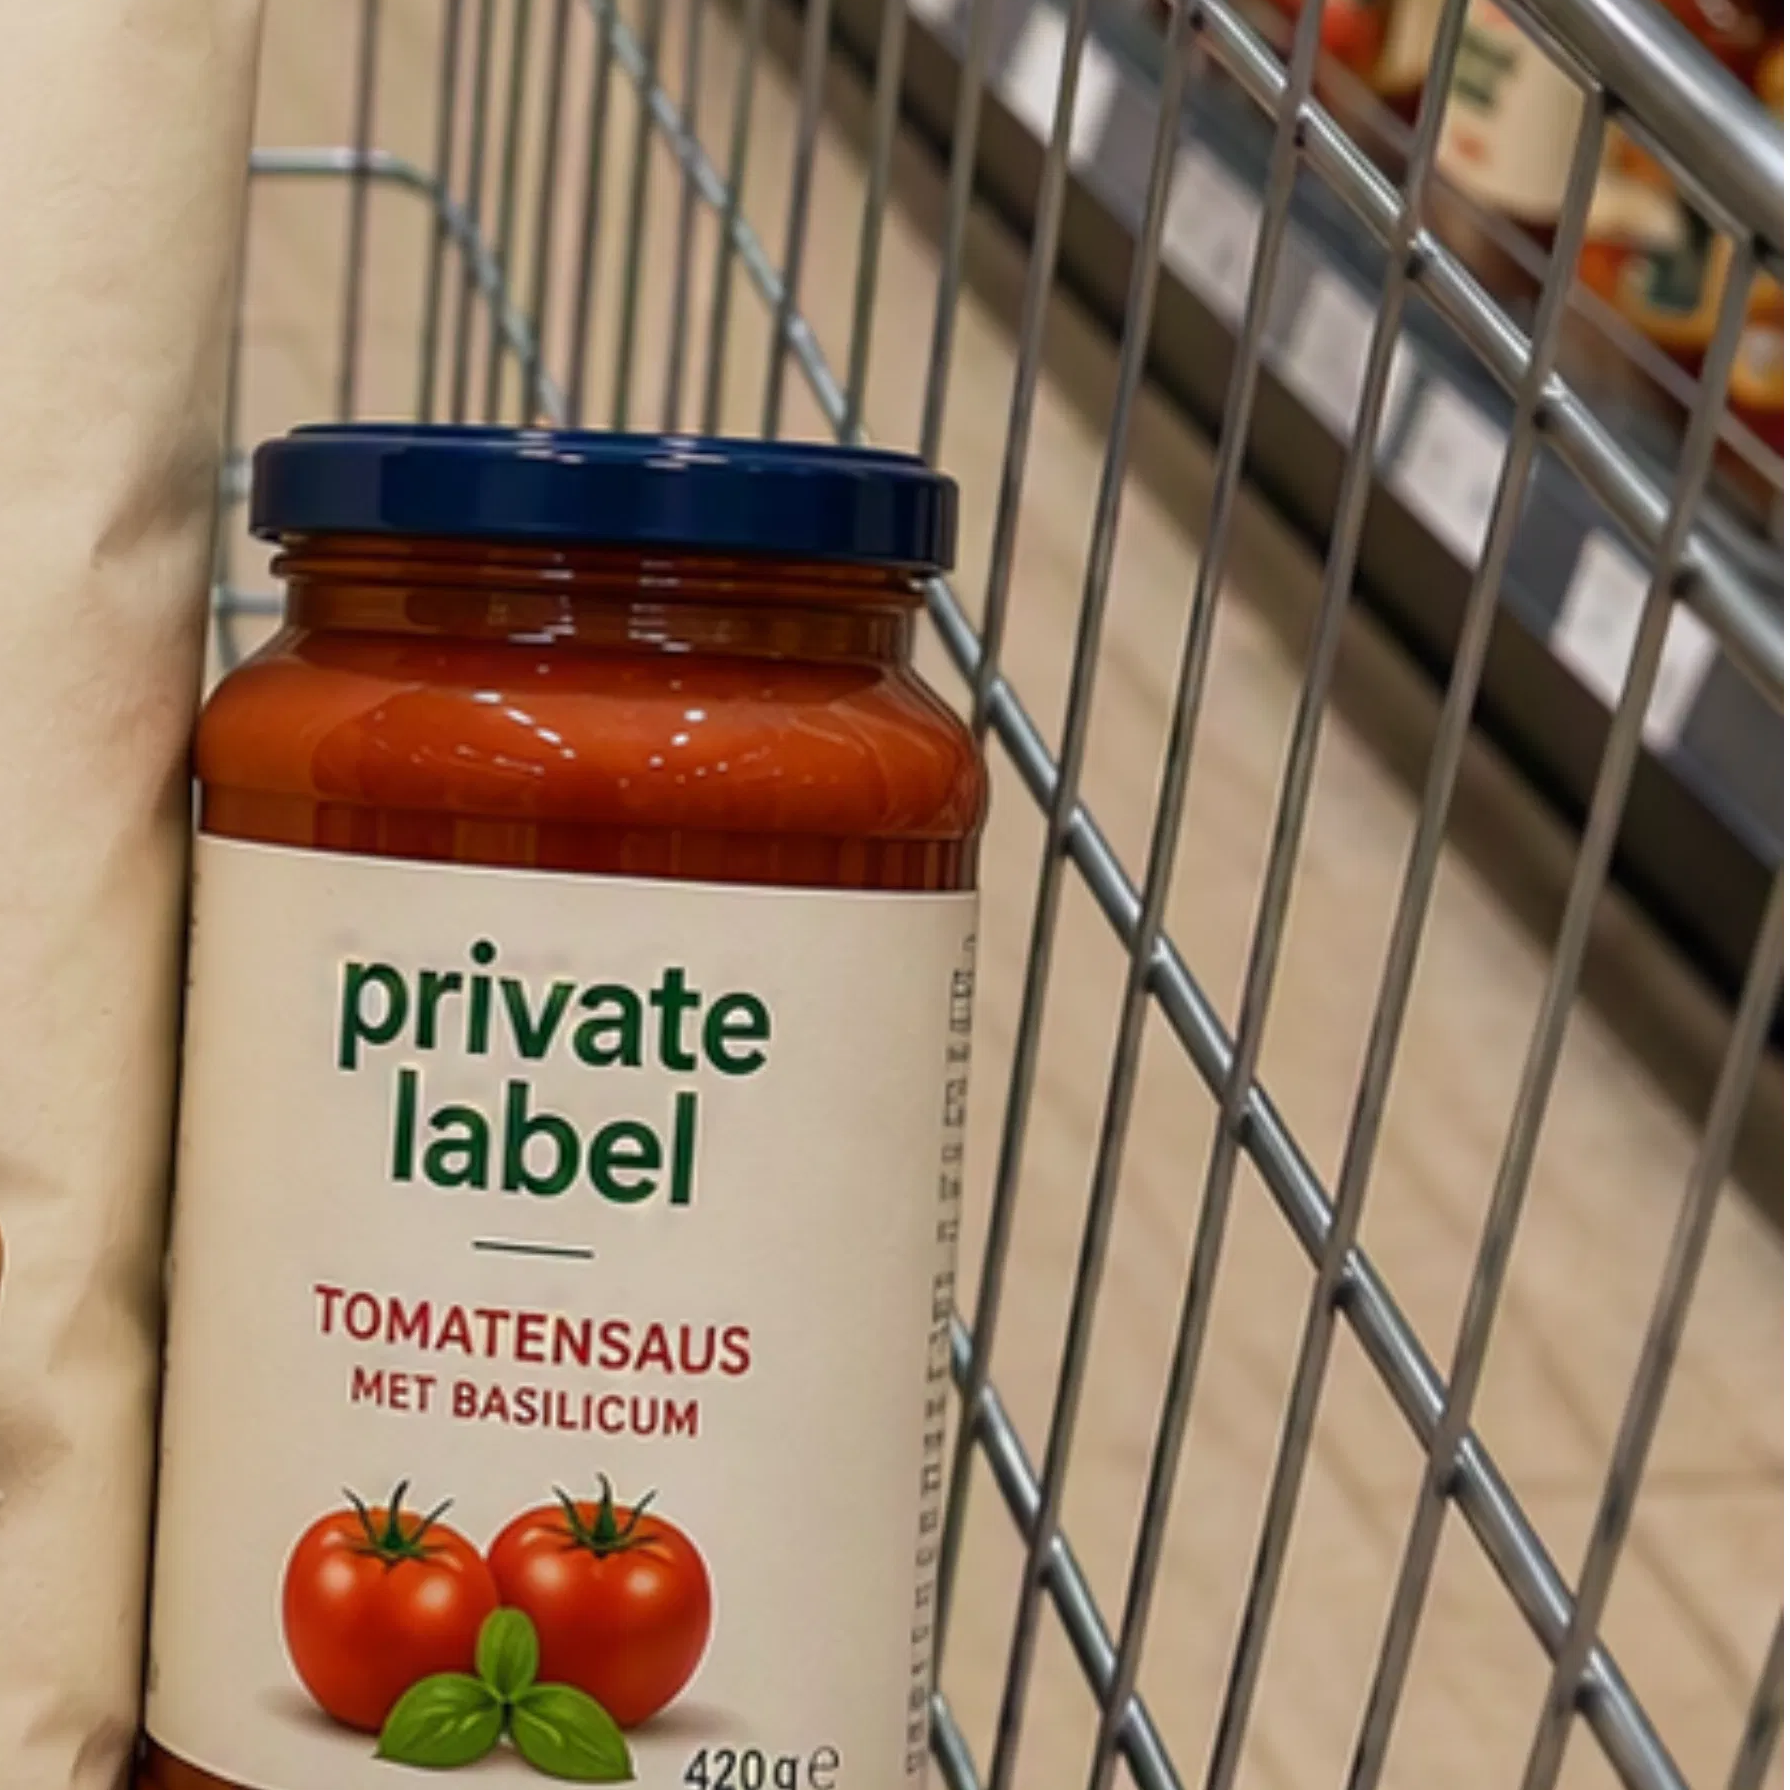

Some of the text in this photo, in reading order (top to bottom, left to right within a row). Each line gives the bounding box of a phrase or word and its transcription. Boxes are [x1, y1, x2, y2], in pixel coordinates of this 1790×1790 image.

[338, 939, 771, 1076] private
[391, 1068, 698, 1207] label
[314, 1283, 751, 1376] TOMATENSAUS
[351, 1366, 698, 1438] MET BASILICUM
